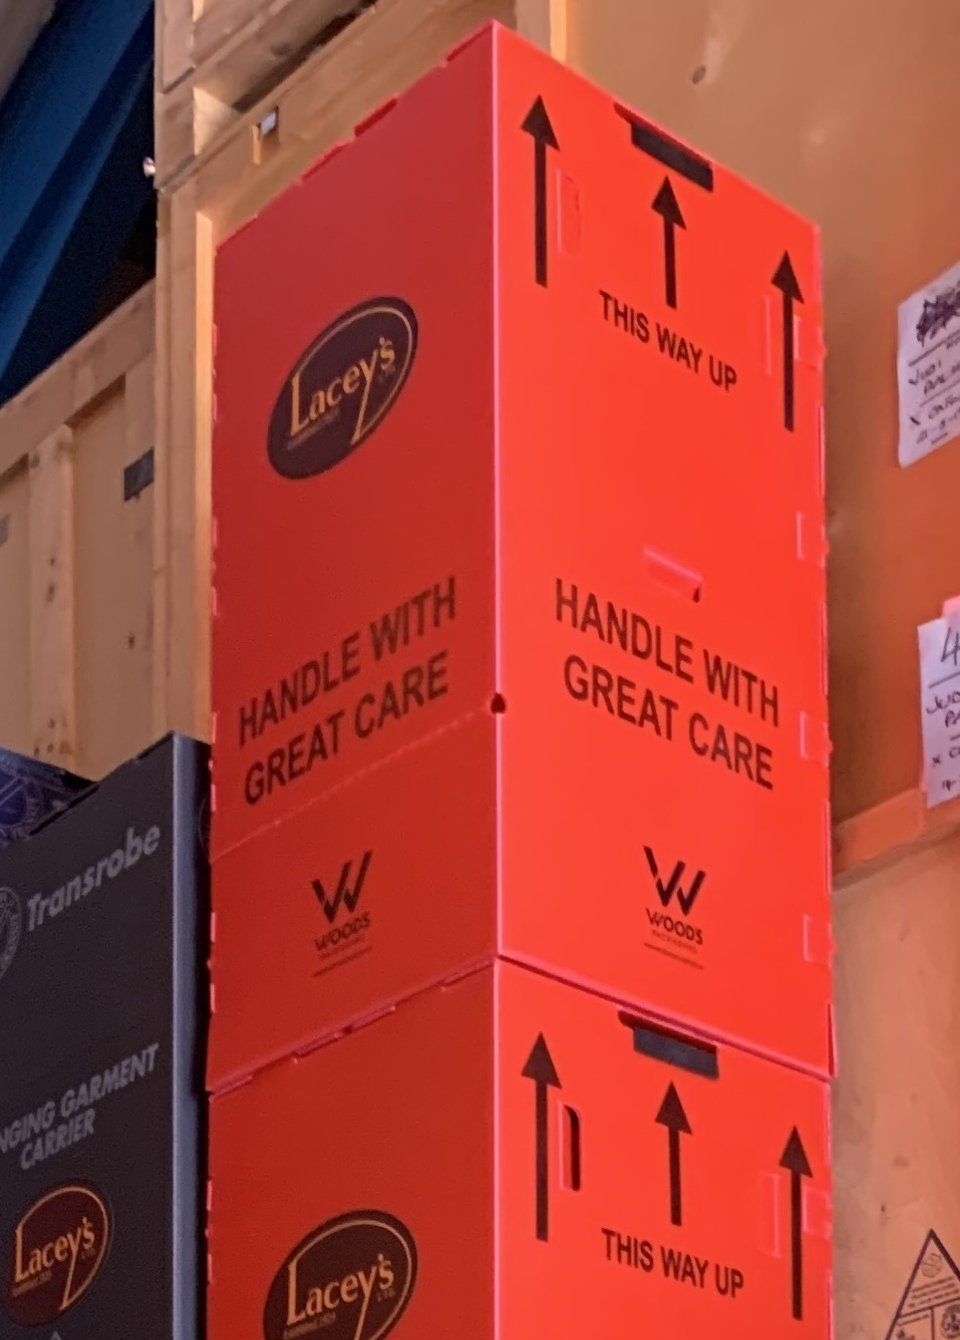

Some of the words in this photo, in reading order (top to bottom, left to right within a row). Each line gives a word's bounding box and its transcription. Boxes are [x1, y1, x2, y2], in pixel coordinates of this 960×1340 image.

[599, 290, 650, 342] THIS
[657, 330, 703, 374] WAY
[709, 352, 737, 393] UP
[240, 633, 361, 746] HANDLE
[369, 576, 456, 662] WITH
[555, 577, 694, 684] HANDLE
[703, 648, 781, 728] WITH
[245, 713, 343, 806] GREAT
[354, 651, 449, 739] CARE
[564, 655, 680, 740] GREAT
[689, 711, 774, 791] CARE
[27, 822, 161, 931] Transrobe
[60, 1042, 159, 1116] GARMENT
[21, 1108, 96, 1170] CARRIER
[601, 1227, 654, 1273] THIS
[662, 1246, 709, 1290] WAY
[715, 1262, 744, 1299] UP
